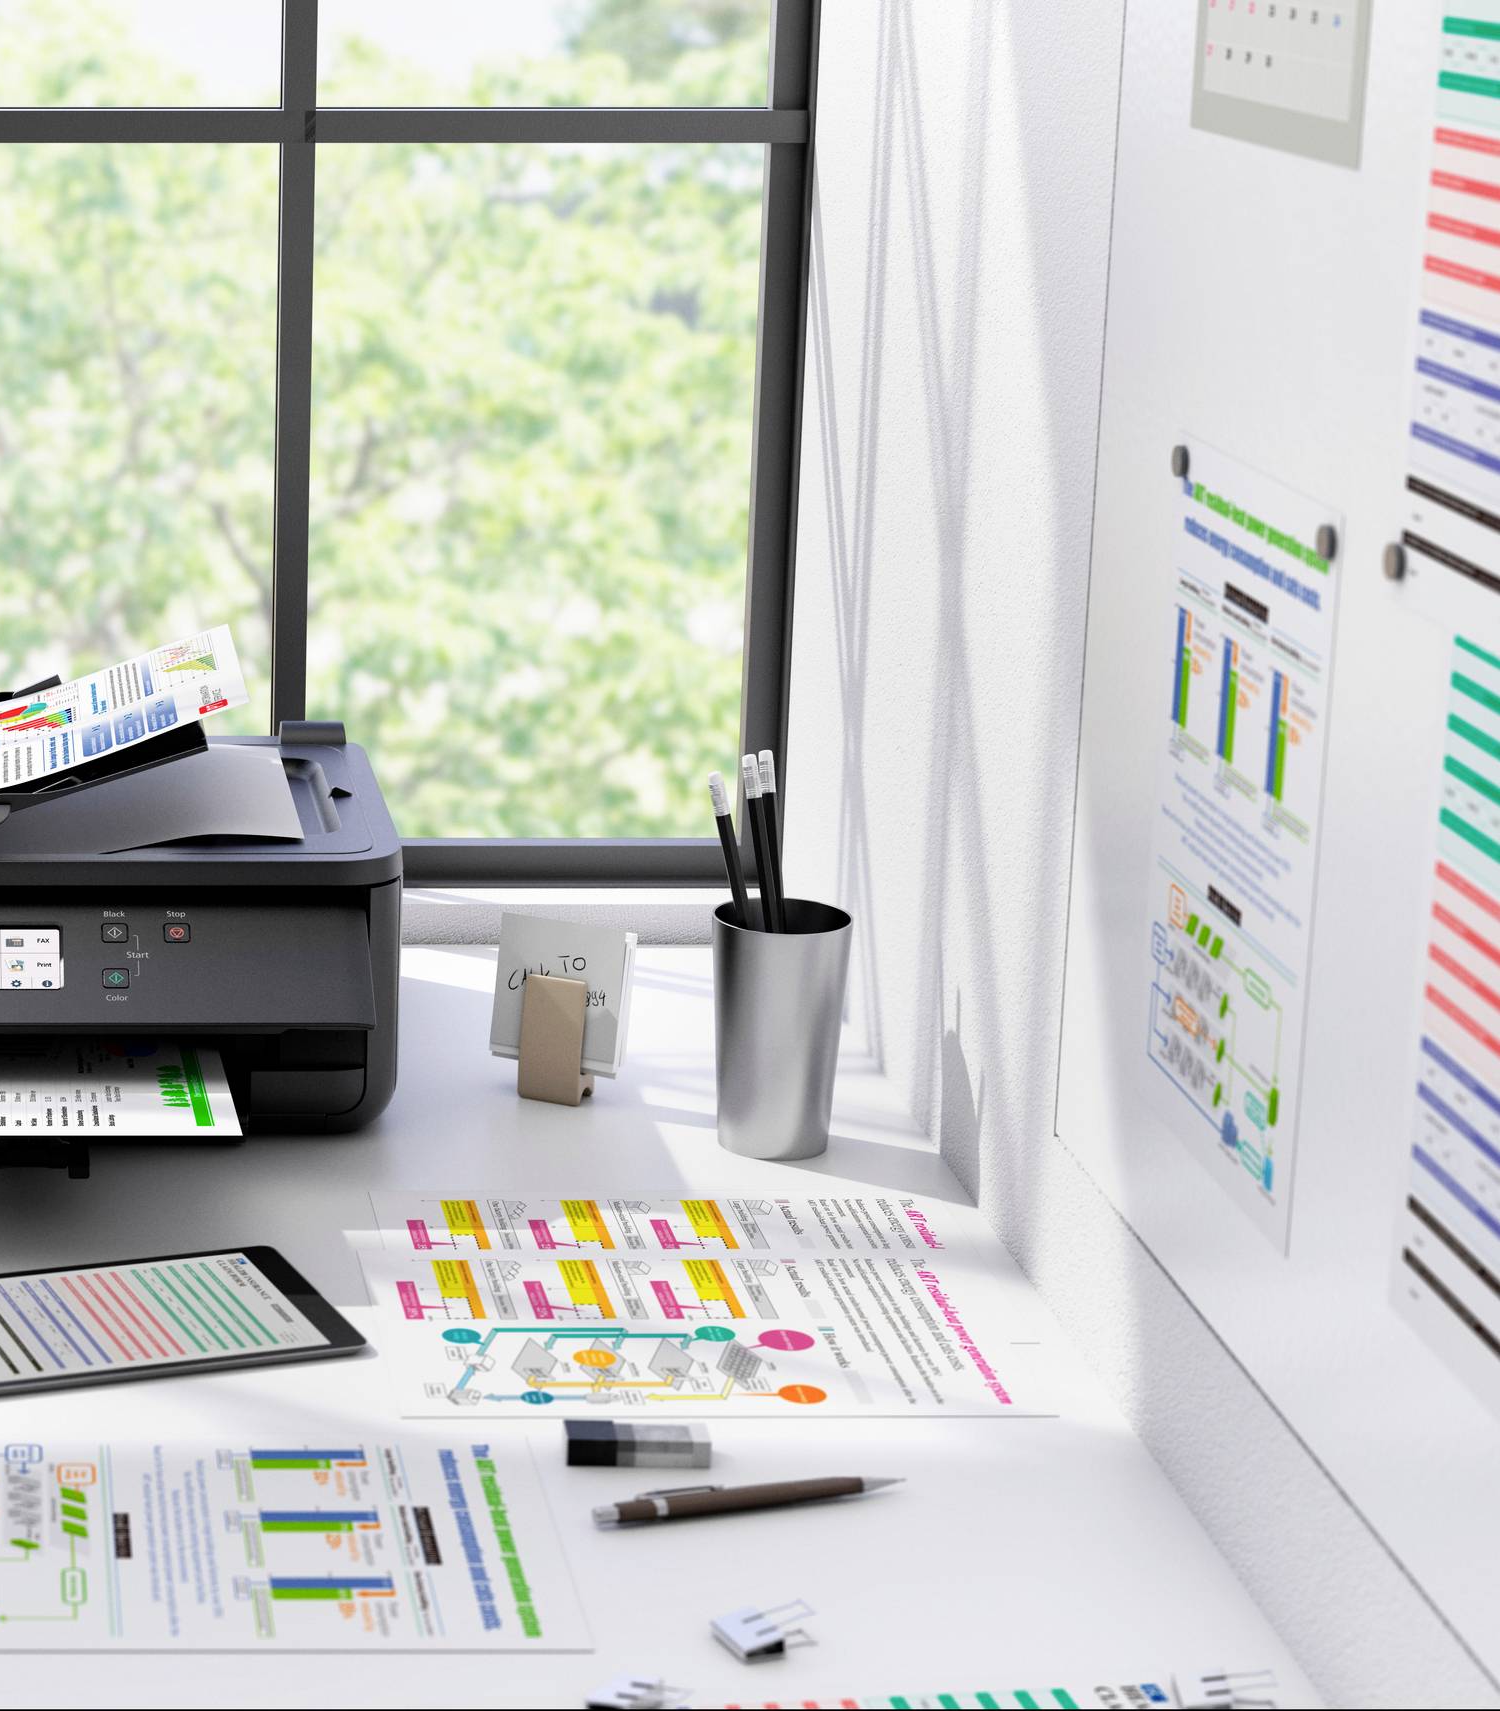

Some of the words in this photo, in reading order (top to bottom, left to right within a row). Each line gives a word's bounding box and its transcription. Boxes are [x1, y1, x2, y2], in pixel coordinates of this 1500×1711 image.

[103, 910, 125, 918] Black
[166, 910, 186, 919] Stop
[126, 951, 150, 959] Start
[557, 955, 587, 973] TO
[105, 994, 129, 1002] Color
[917, 1270, 941, 1284] ART
